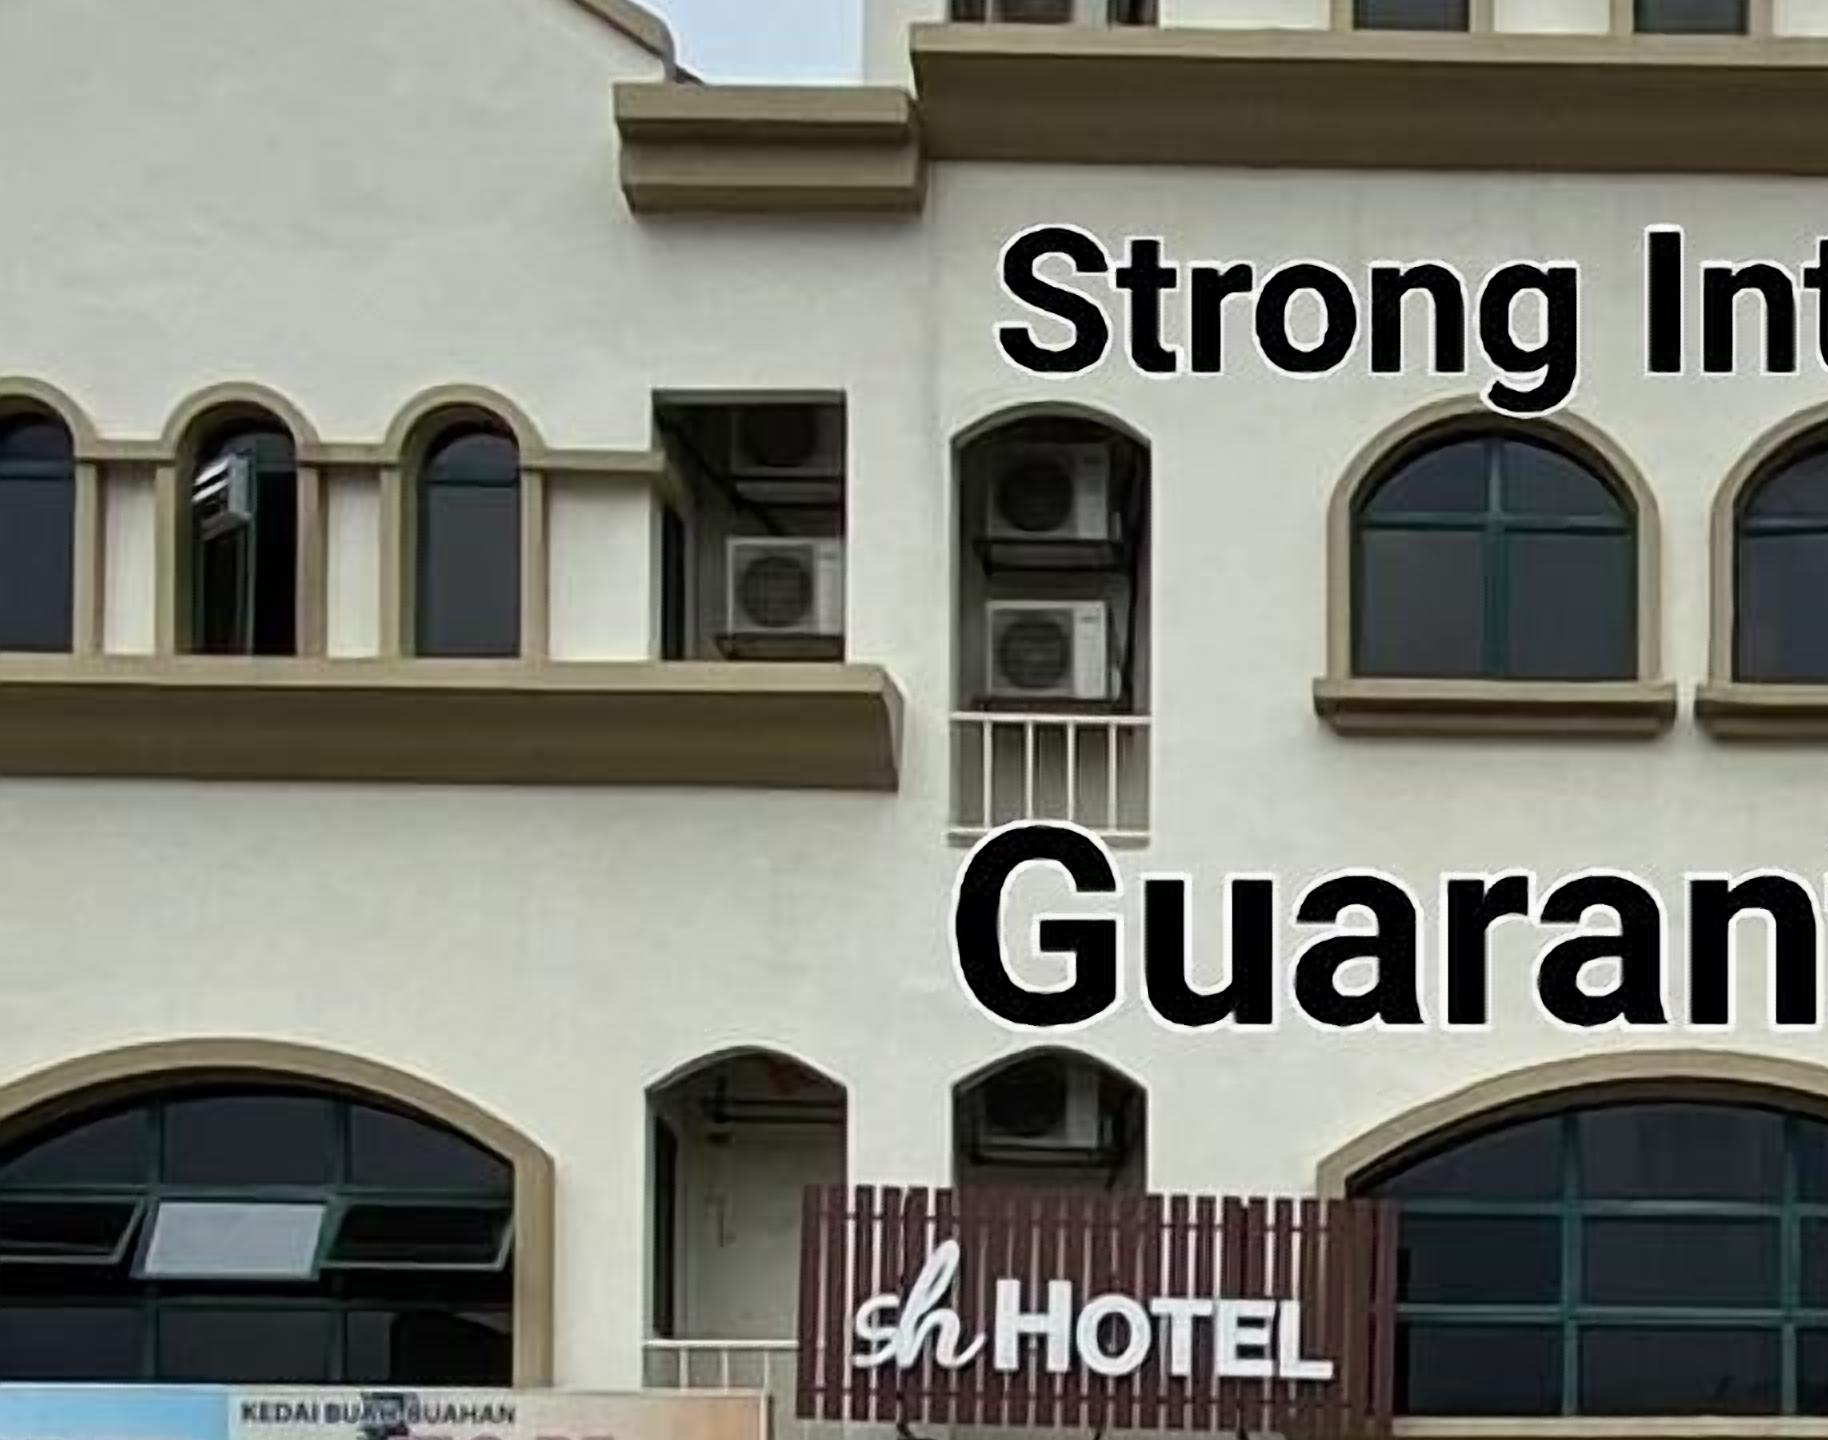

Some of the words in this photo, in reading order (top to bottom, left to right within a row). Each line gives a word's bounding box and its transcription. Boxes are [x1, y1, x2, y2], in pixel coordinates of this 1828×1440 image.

[853, 1239, 987, 1368] sh
[993, 1278, 1334, 1380] HOTEL
[241, 1400, 320, 1424] KEDAI
